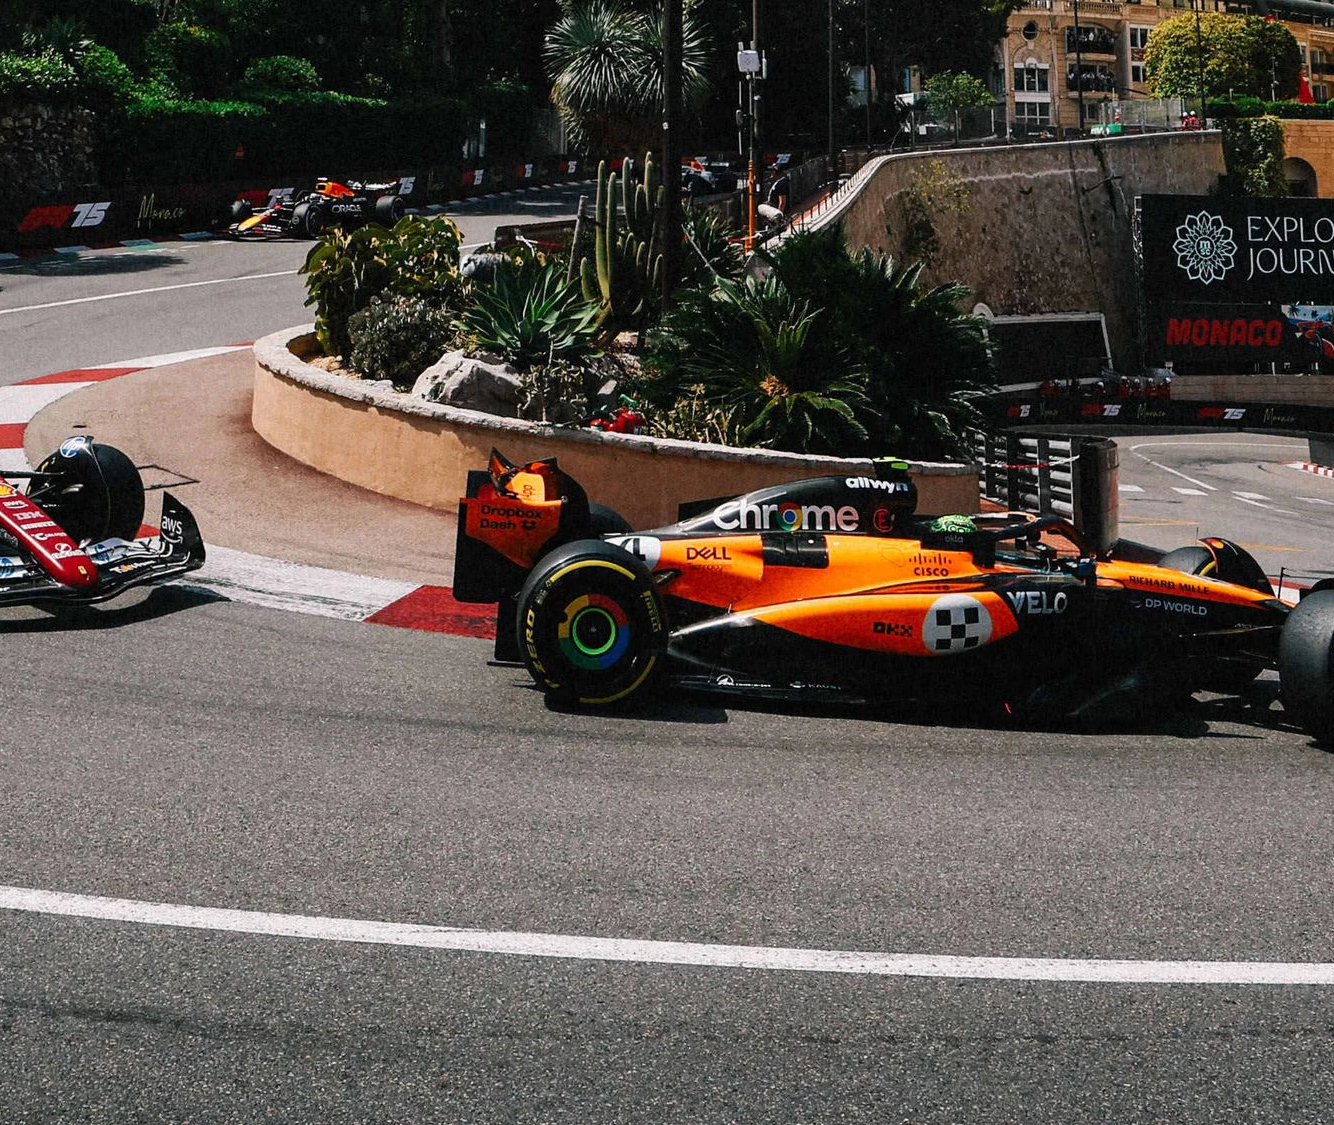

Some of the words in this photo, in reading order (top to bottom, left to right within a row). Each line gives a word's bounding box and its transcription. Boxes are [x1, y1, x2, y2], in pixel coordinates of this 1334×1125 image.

[71, 202, 112, 228] 75
[138, 193, 187, 229] Monaco
[1166, 318, 1283, 347] MONACO
[1102, 404, 1122, 416] 75
[1223, 408, 1246, 419] 75
[845, 477, 909, 494] allwyn
[481, 504, 544, 519] Dropbox
[712, 499, 860, 533] Chrome
[161, 516, 183, 535] aws
[480, 519, 517, 530] Dash
[944, 534, 964, 544] okta
[687, 547, 732, 561] DELL
[913, 567, 949, 577] CISCO
[1129, 575, 1175, 590] RICHARD
[1178, 584, 1211, 595] MILLE
[1006, 592, 1068, 614] VELO
[1145, 598, 1162, 609] DP
[1163, 601, 1208, 616] WORLD
[525, 608, 546, 674] ZERO
